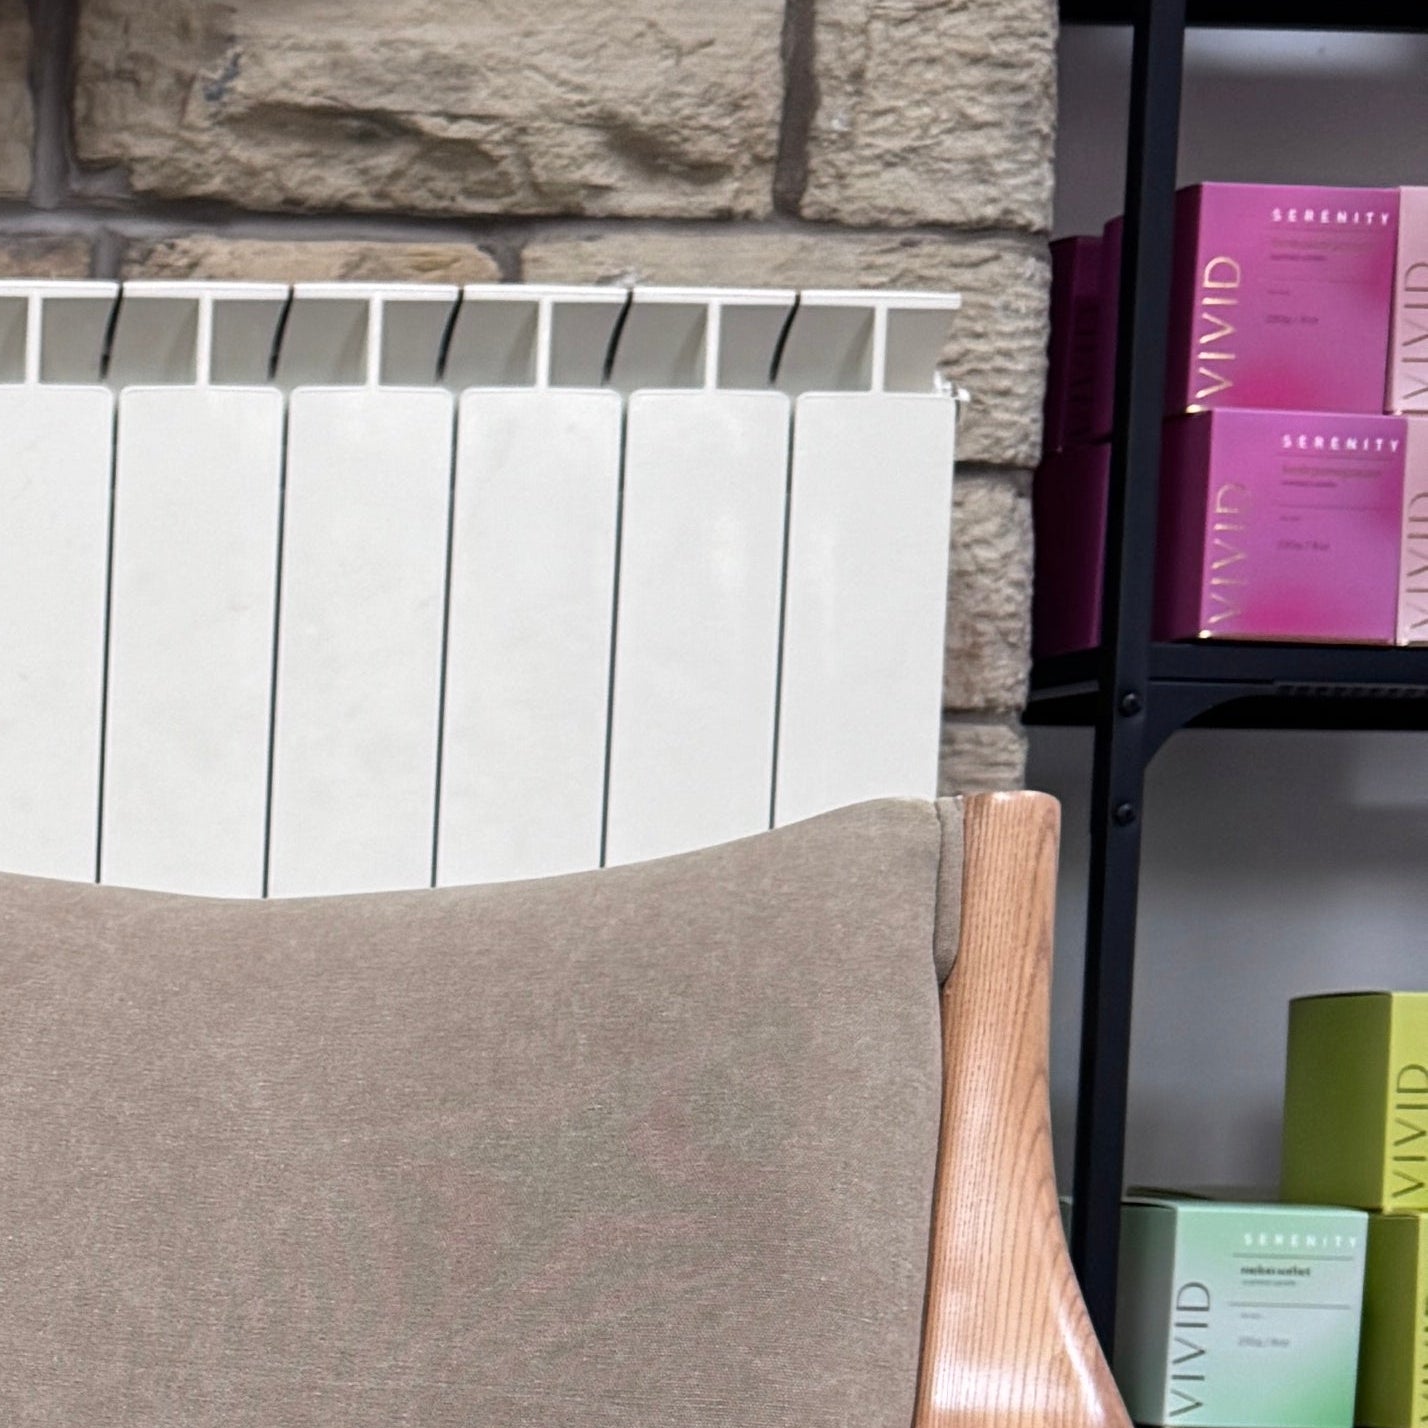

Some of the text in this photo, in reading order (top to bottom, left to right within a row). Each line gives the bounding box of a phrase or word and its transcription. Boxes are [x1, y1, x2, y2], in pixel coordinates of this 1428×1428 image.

[1272, 208, 1390, 225] SERENITY
[1195, 256, 1241, 399] VIVID
[1282, 434, 1400, 452] SERENITY
[1208, 483, 1249, 624] VIVID
[1392, 1064, 1428, 1198] VIVID
[1244, 1231, 1358, 1248] SERENITY
[1169, 1281, 1210, 1417] VIVID
